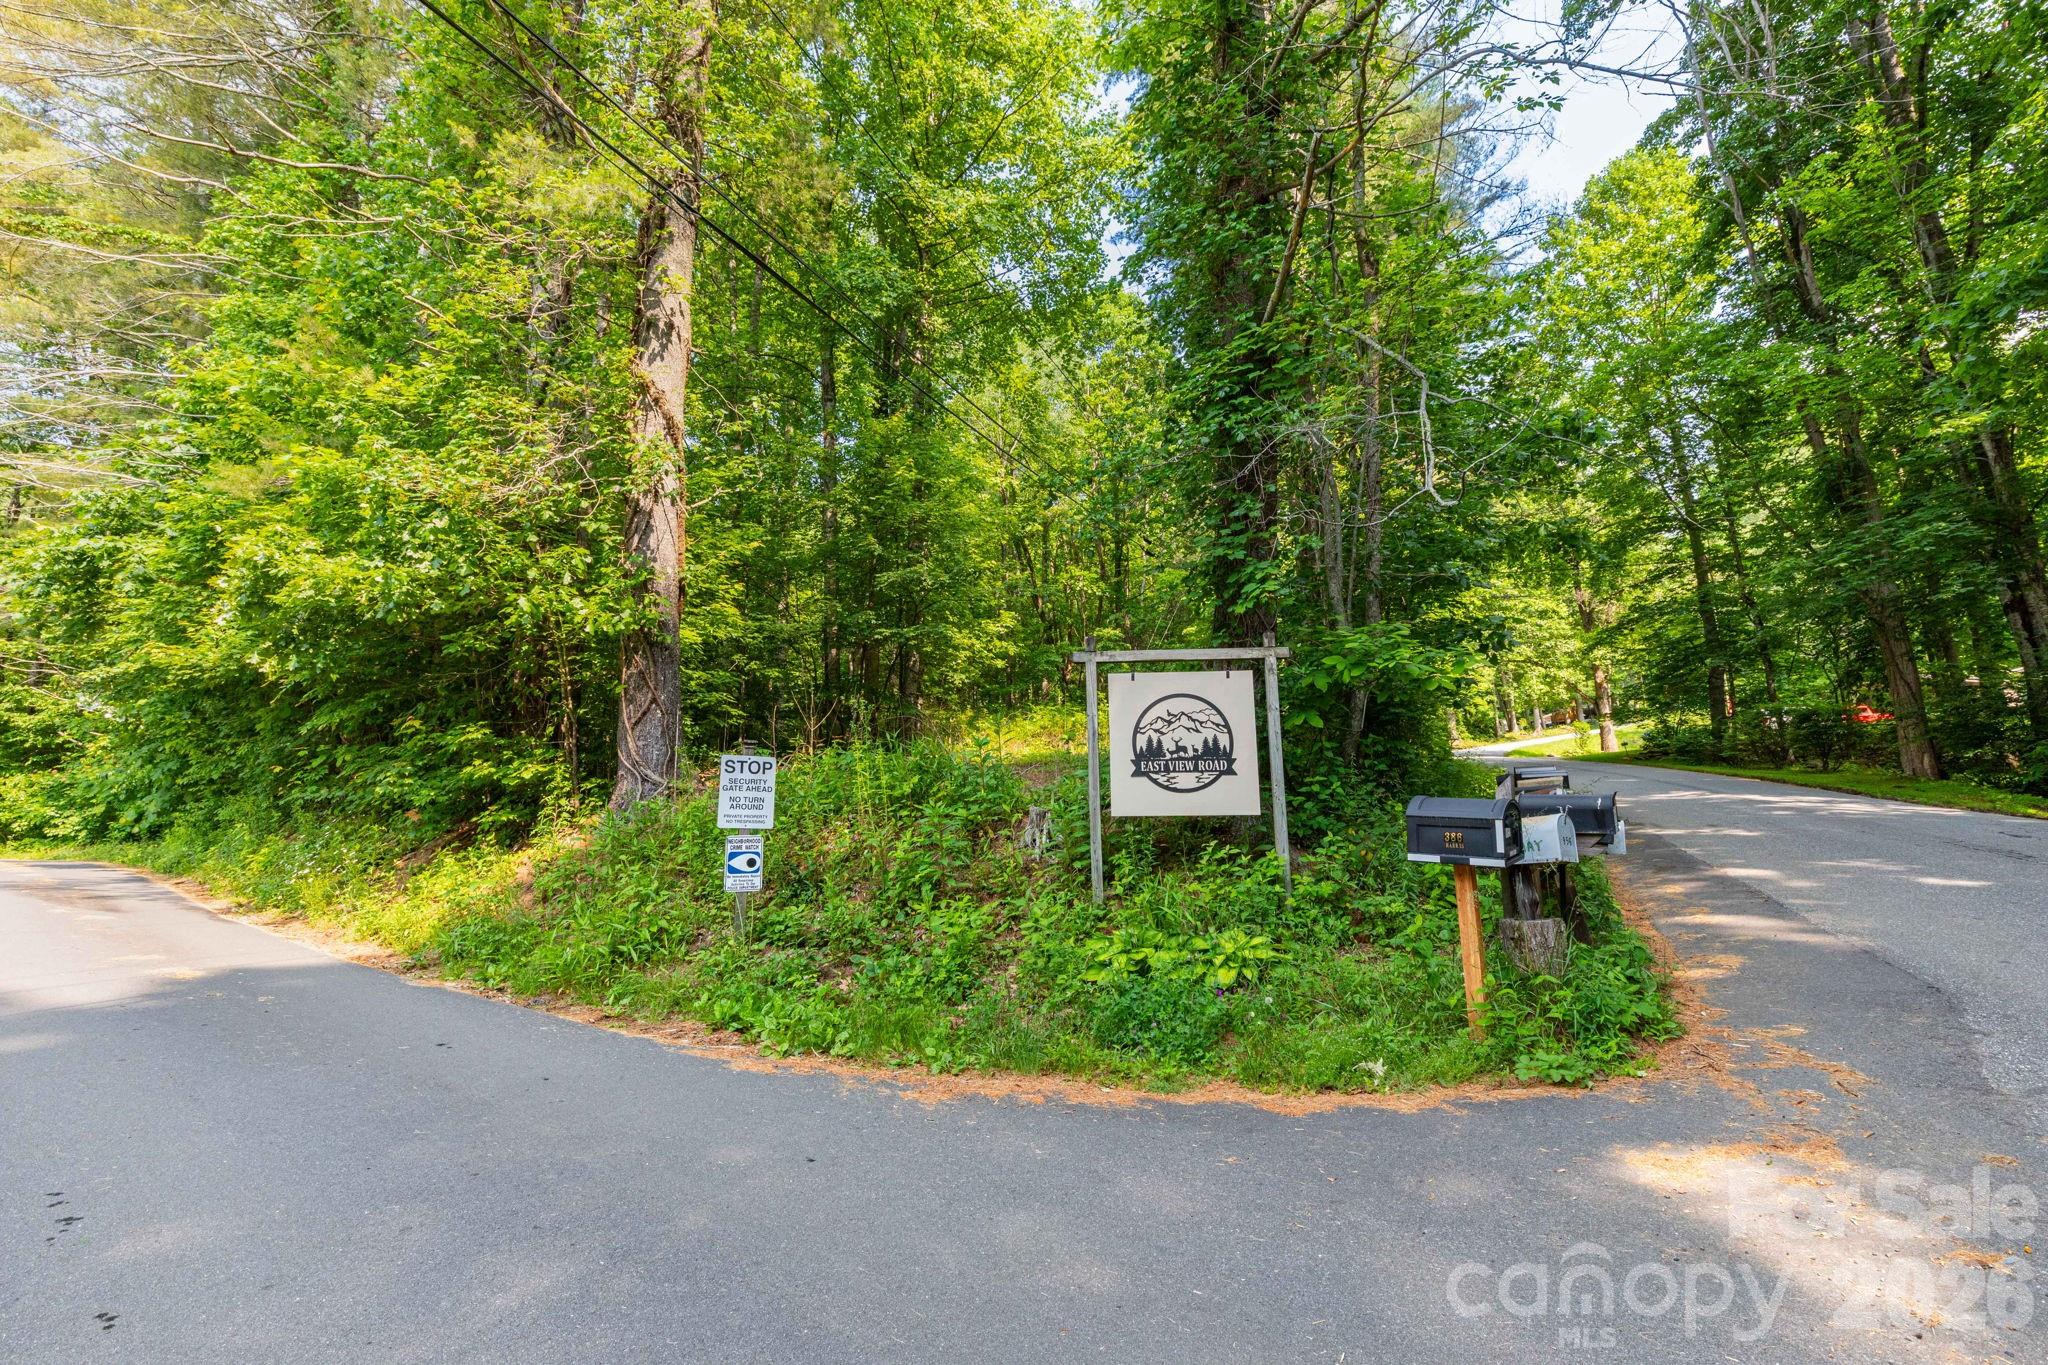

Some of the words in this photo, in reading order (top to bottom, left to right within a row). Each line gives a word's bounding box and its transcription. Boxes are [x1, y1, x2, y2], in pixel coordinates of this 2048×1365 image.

[725, 759, 773, 775] STOP
[1141, 760, 1166, 772] EAST
[1168, 760, 1195, 772] VIEW
[1198, 759, 1228, 771] ROAD
[728, 777, 768, 785] SECURITY
[722, 784, 743, 792] GATE
[745, 785, 773, 793] AHEAD
[743, 796, 765, 804] TURN
[729, 803, 764, 811] AROUND
[1444, 831, 1463, 842] 386
[1524, 839, 1543, 852] AY
